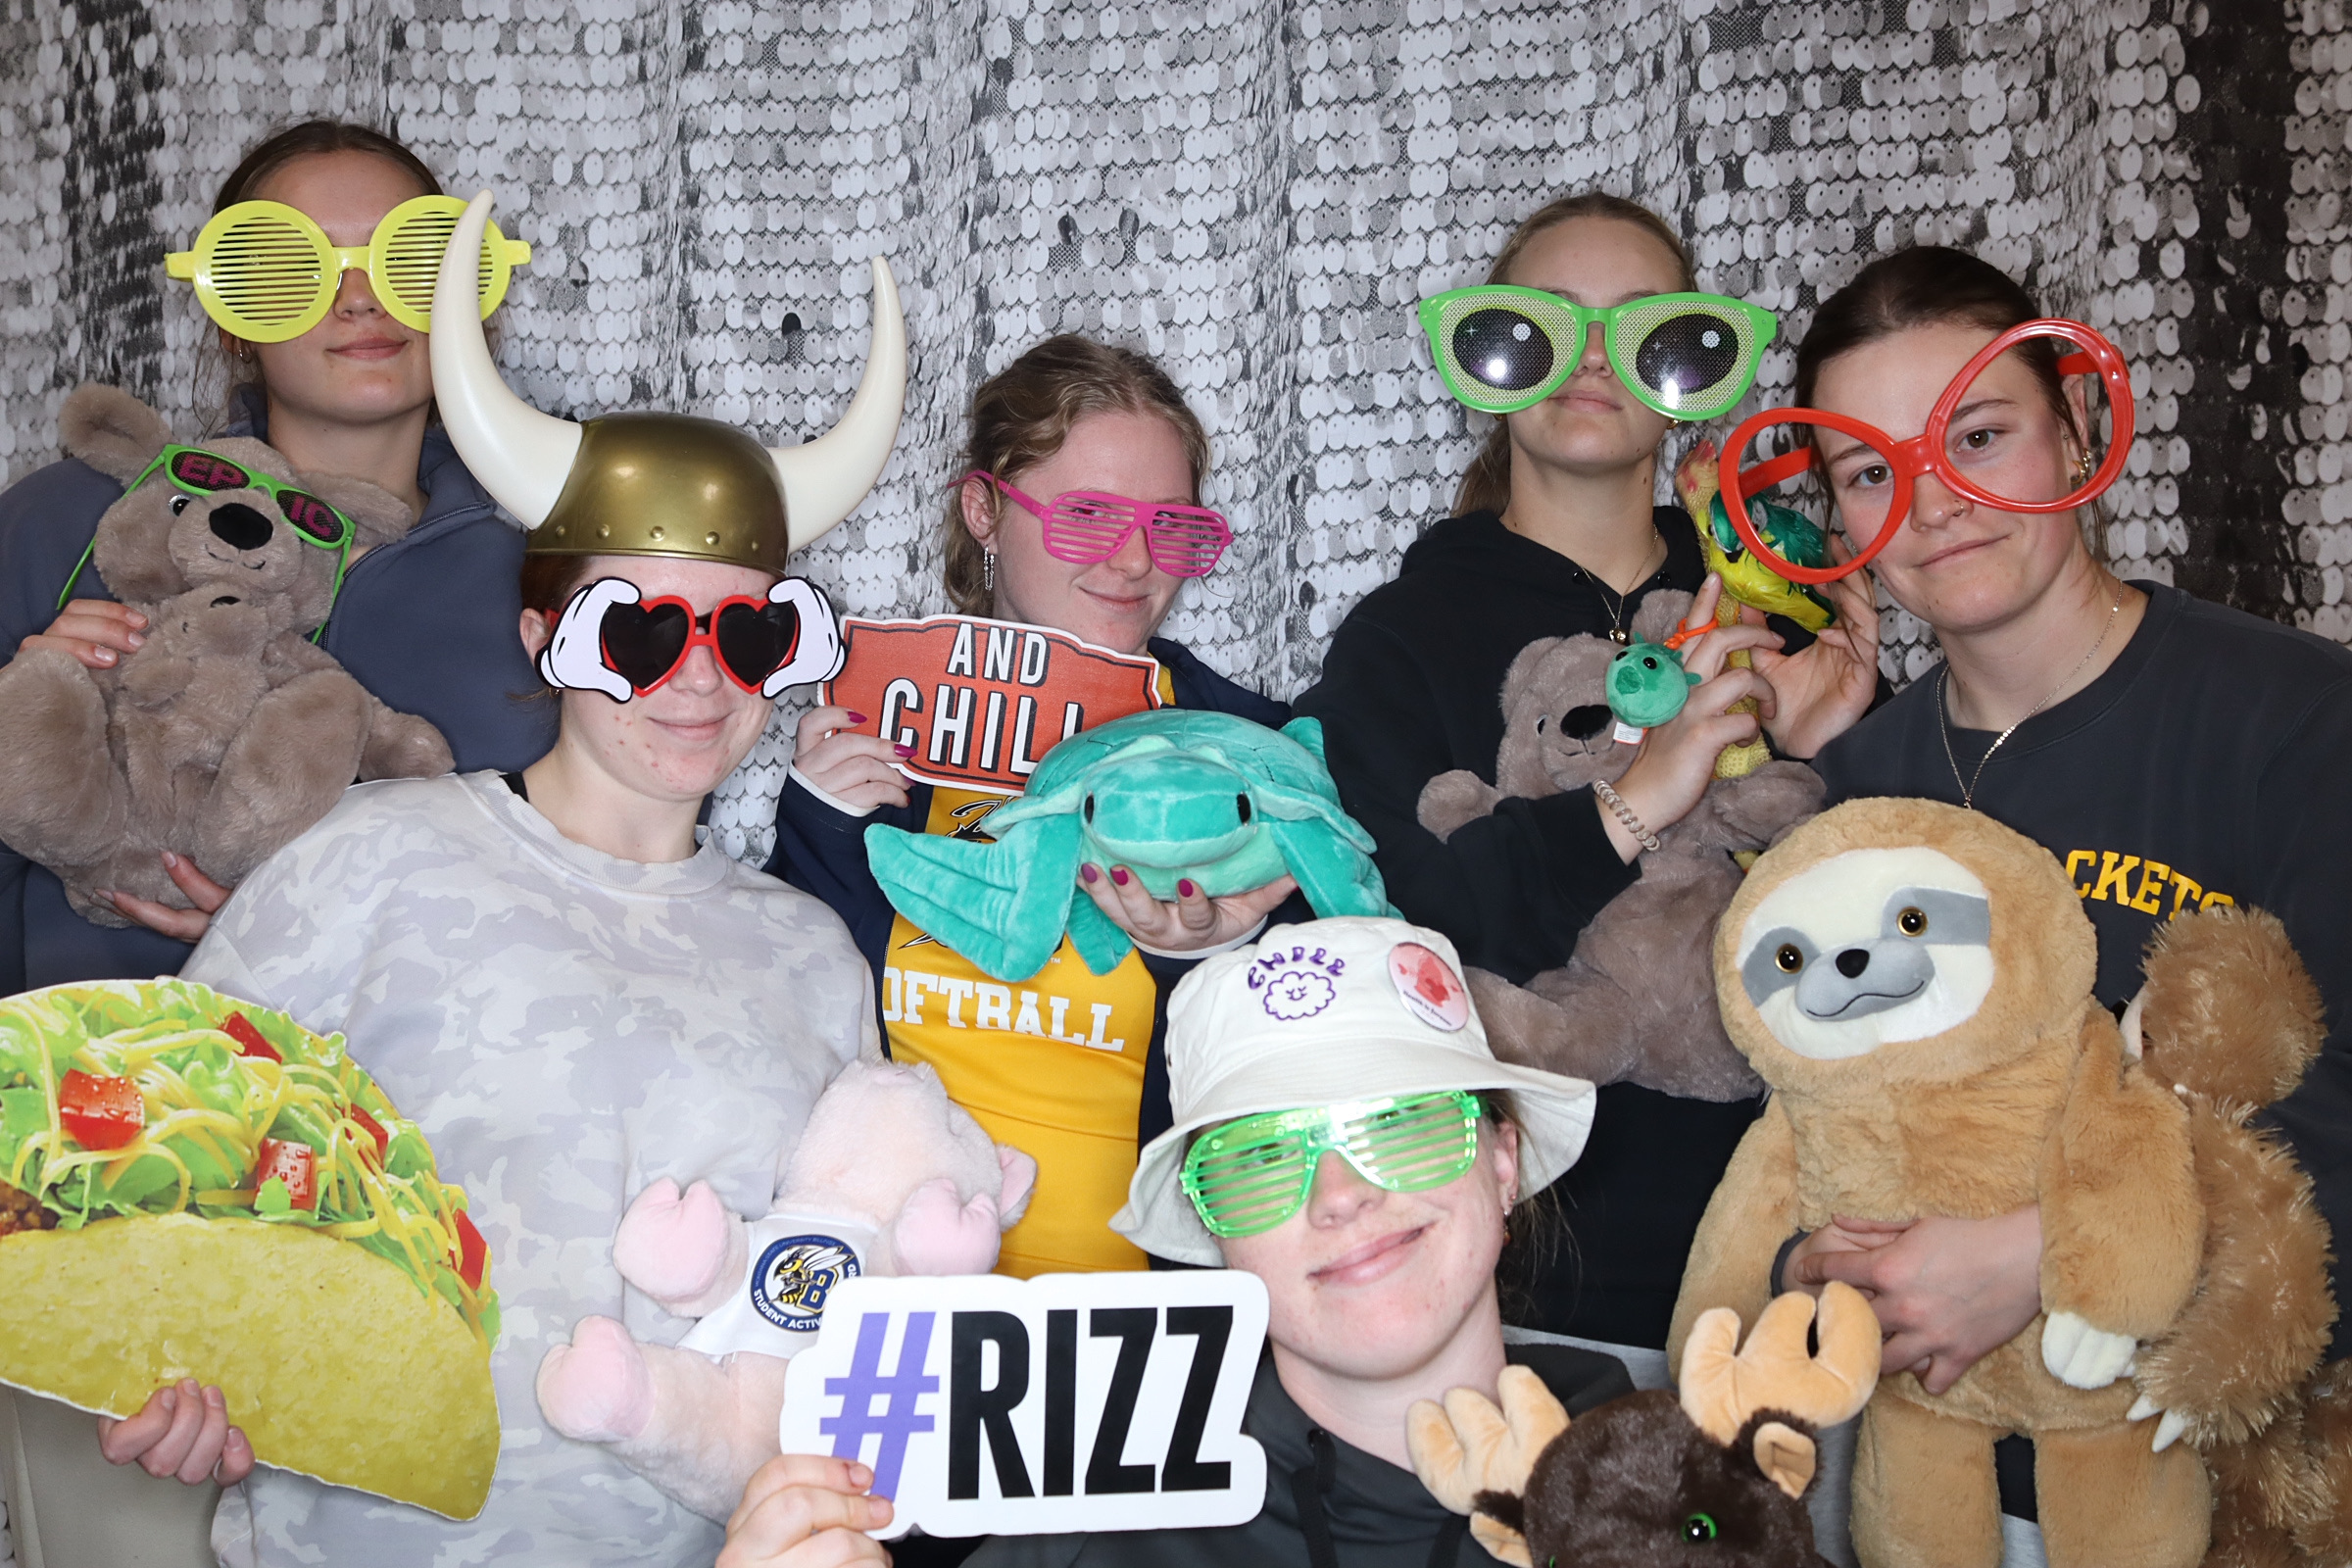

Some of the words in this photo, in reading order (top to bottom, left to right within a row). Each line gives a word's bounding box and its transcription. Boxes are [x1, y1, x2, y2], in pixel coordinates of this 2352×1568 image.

[947, 622, 1050, 686] AND
[2065, 850, 2234, 921] CKET
[883, 966, 1125, 1052] OFTBALL
[754, 1288, 788, 1326] STUDENT
[787, 1317, 821, 1330] ACTIV
[819, 1305, 1234, 1502] #RIZZ
